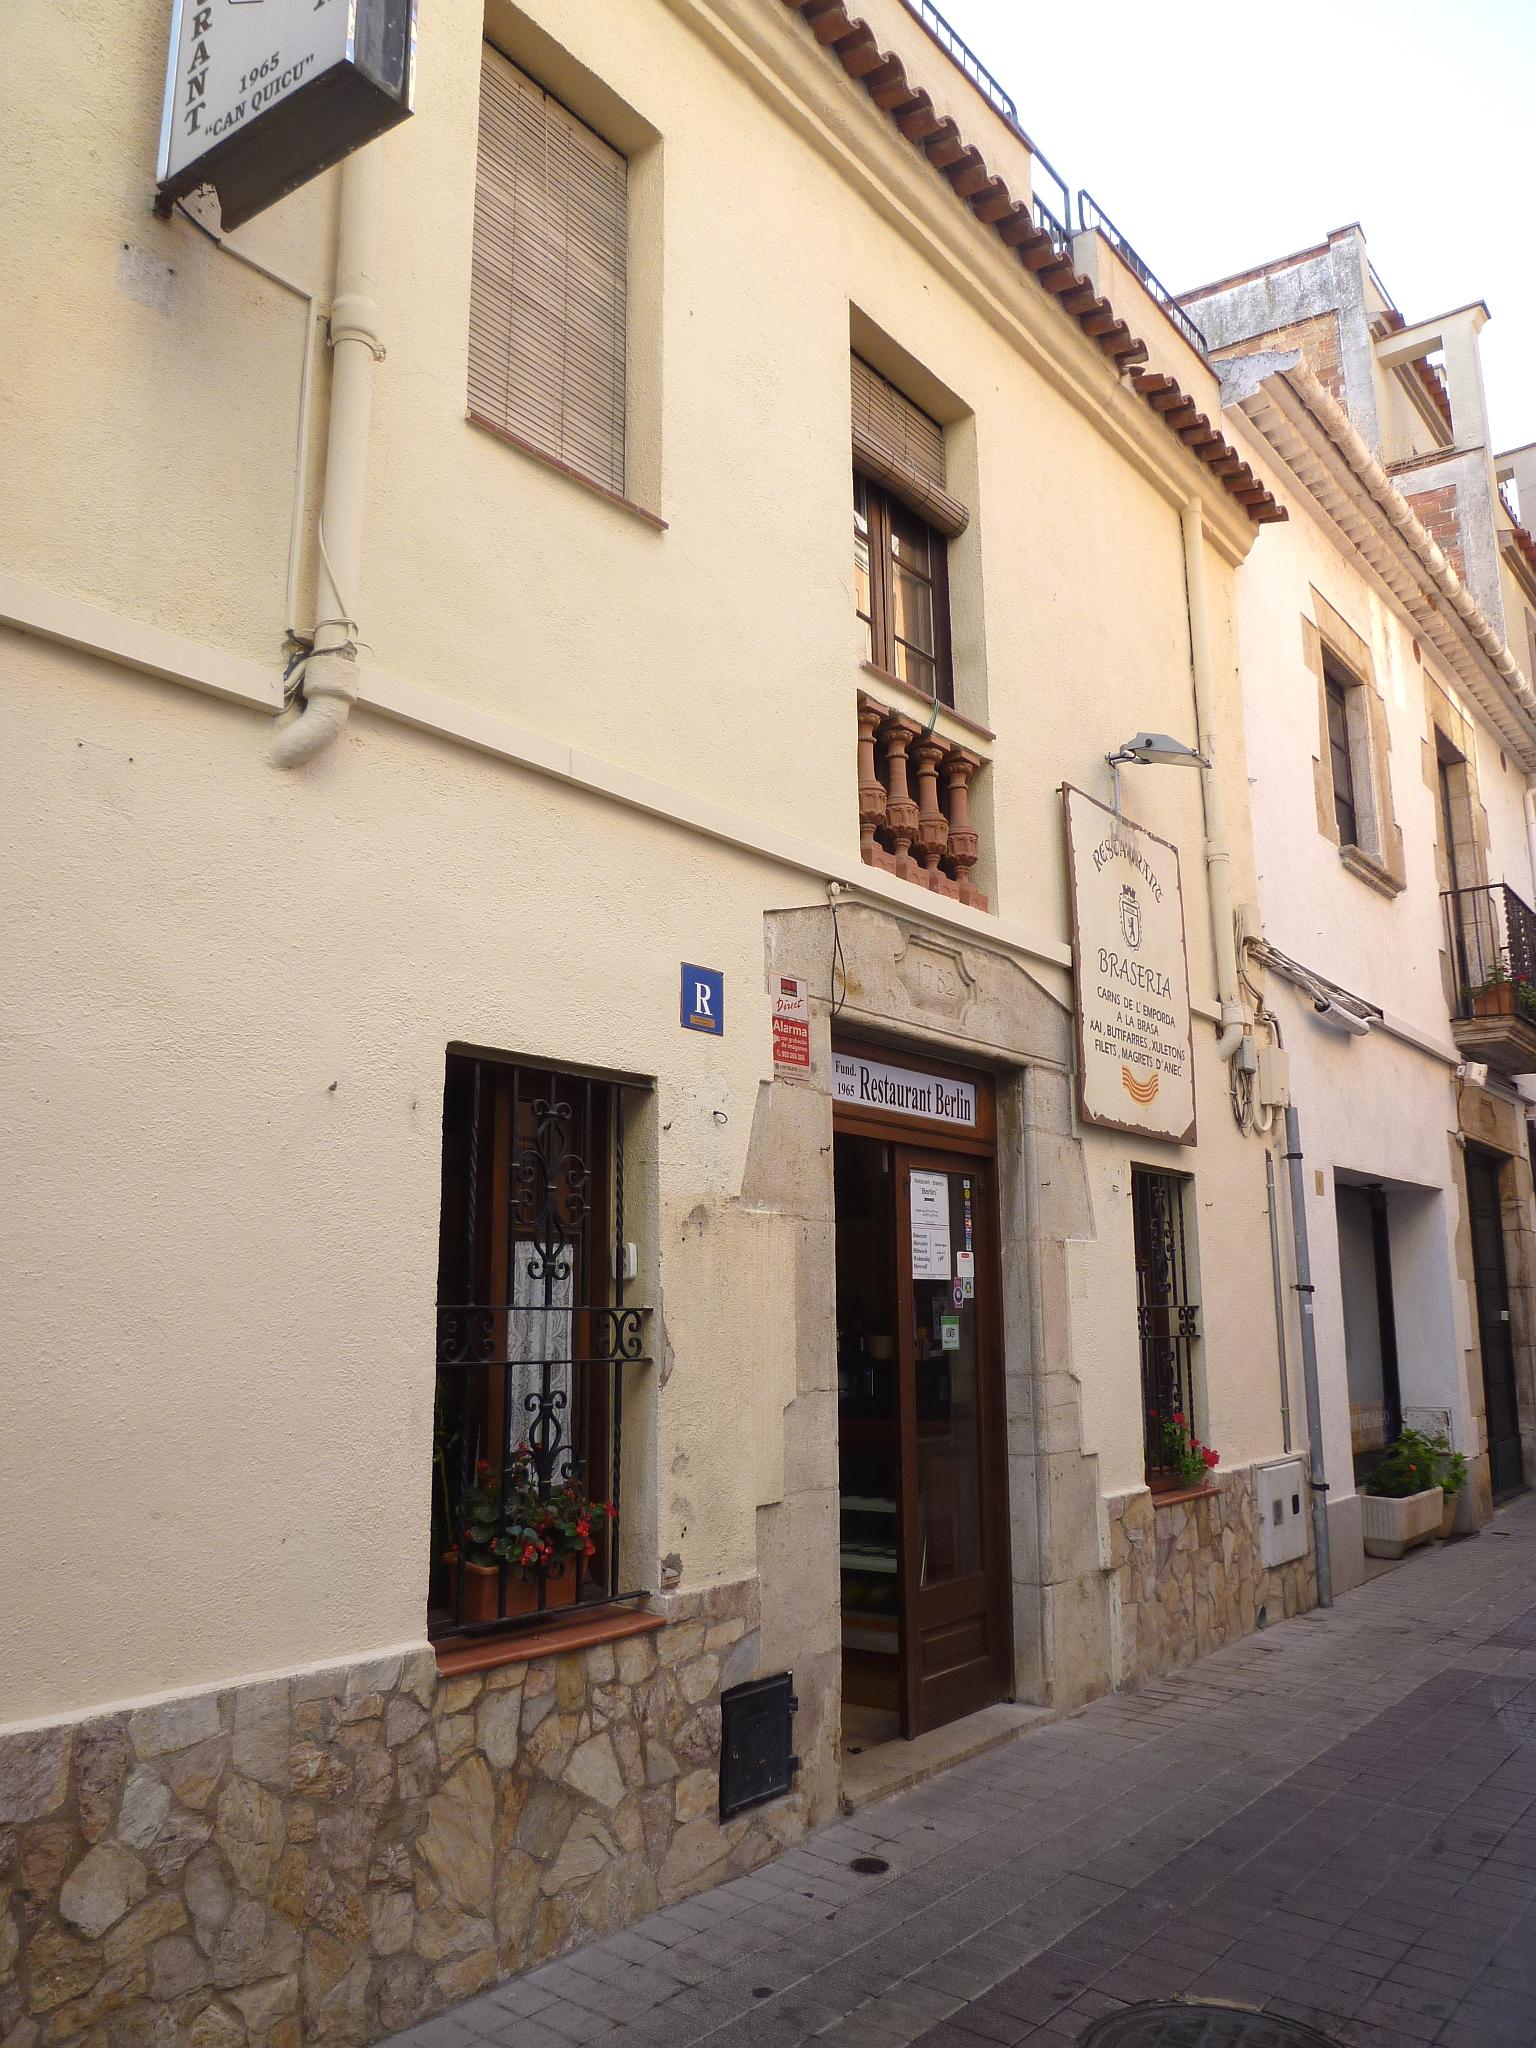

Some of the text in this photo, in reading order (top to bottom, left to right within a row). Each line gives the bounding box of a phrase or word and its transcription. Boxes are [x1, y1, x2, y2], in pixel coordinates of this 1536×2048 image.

[184, 0, 213, 136] RANT
[238, 51, 281, 93] 1965
[1098, 948, 1171, 1000] BRASERIA
[695, 982, 713, 1016] R
[776, 997, 804, 1012] Direct
[1097, 986, 1121, 1005] CARNS
[1124, 997, 1133, 1010] DE
[773, 1019, 807, 1038] Alarma
[1117, 1011, 1159, 1036] A LA BRASA
[1122, 1047, 1154, 1068] MAGRETS
[1151, 1040, 1186, 1061] XULETONS
[835, 1061, 857, 1077] Fund.
[838, 1082, 855, 1097] 1965
[859, 1065, 971, 1121] Restaurant Berlin
